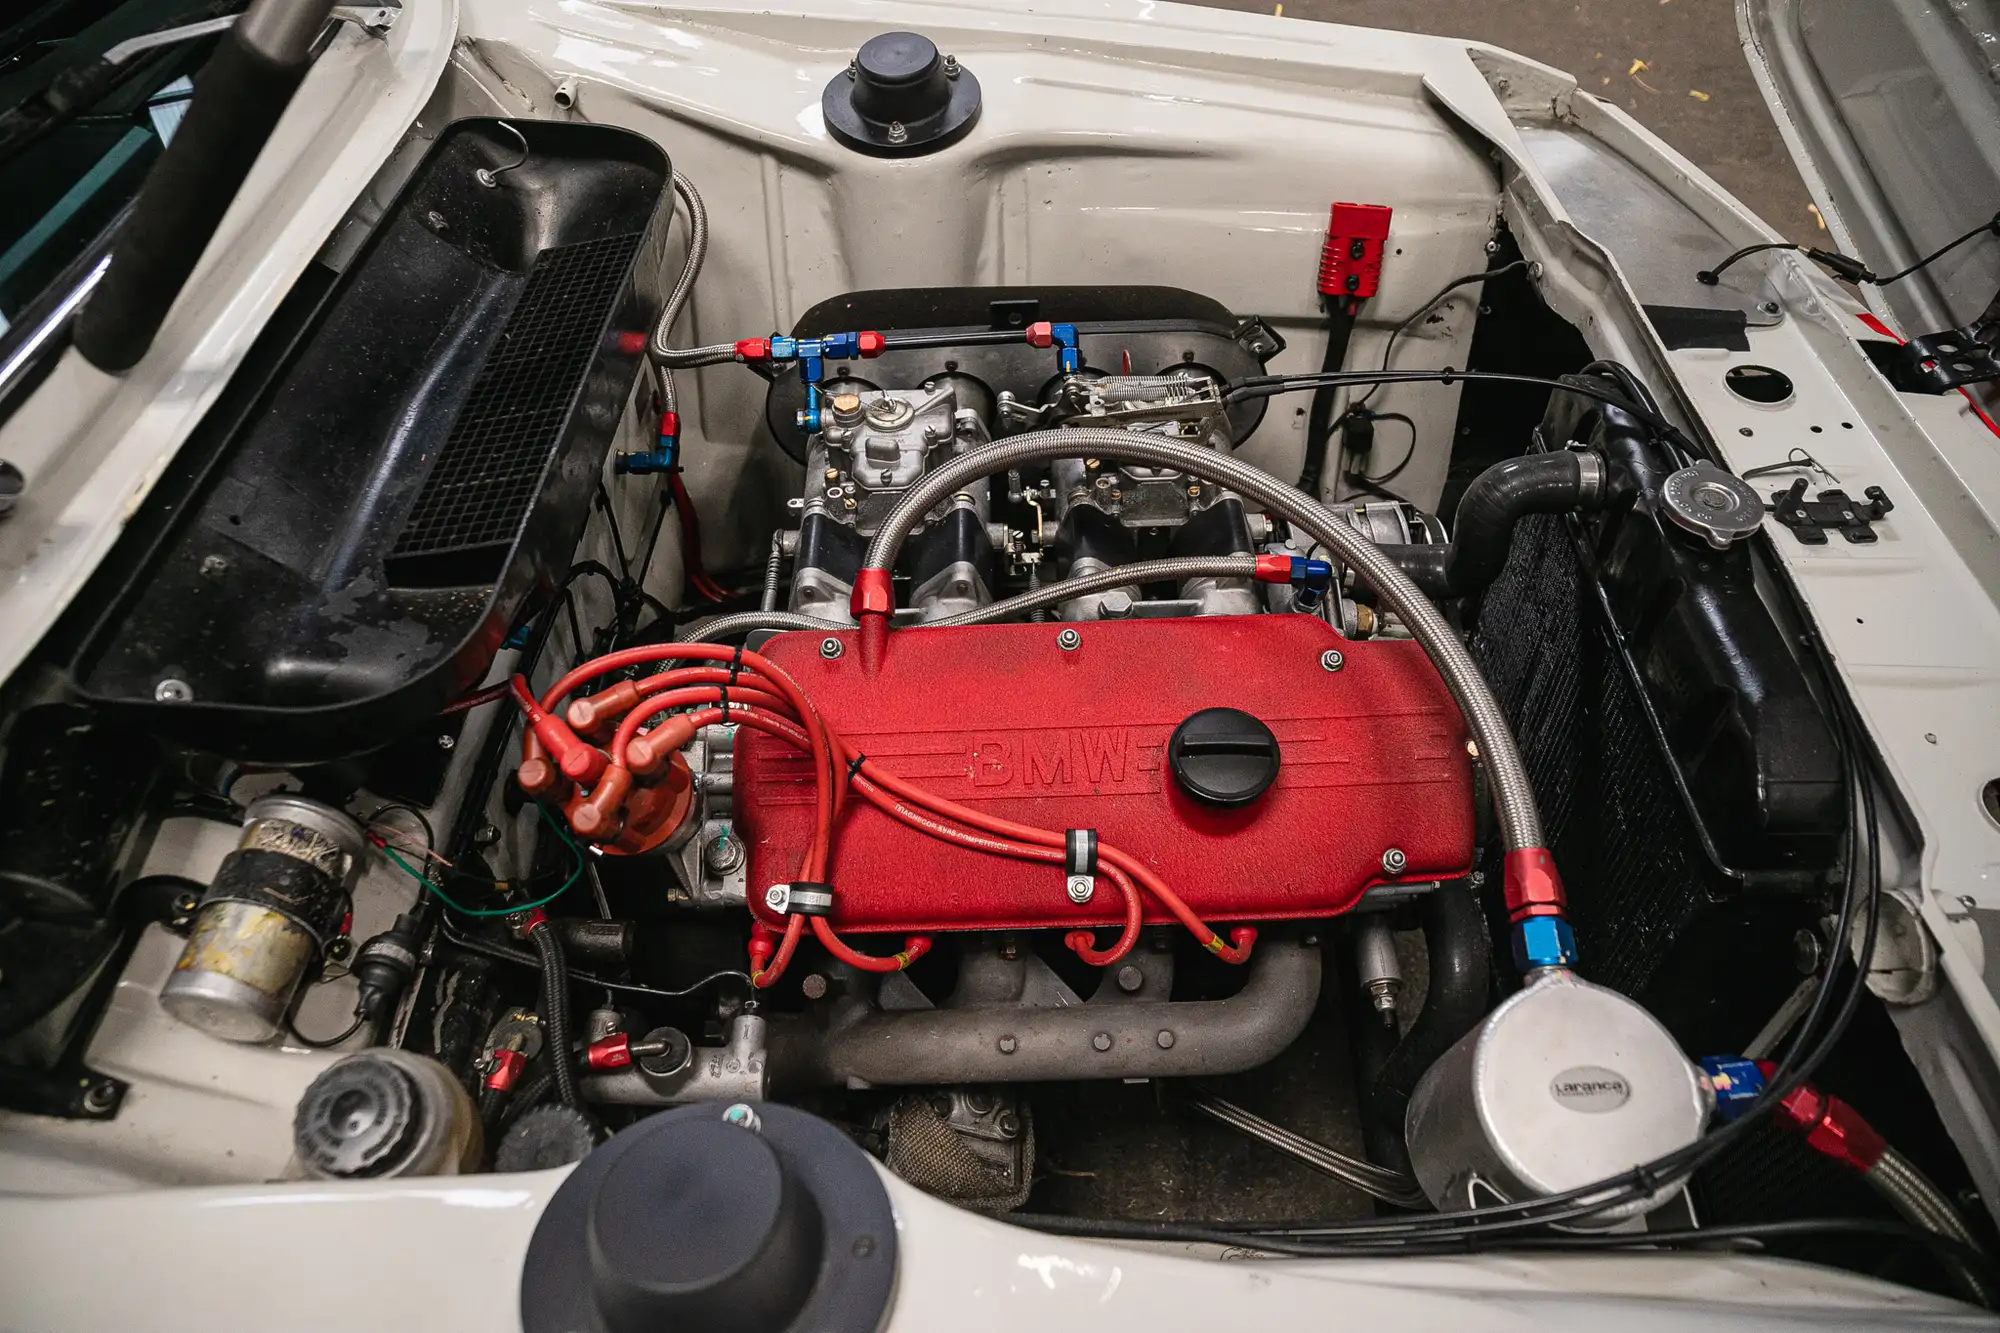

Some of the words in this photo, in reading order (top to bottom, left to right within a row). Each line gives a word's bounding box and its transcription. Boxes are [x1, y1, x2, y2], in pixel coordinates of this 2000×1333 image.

[973, 730, 1130, 787] BMW
[894, 803, 937, 830] MAGNECOR
[957, 832, 1009, 851] COMPETITION
